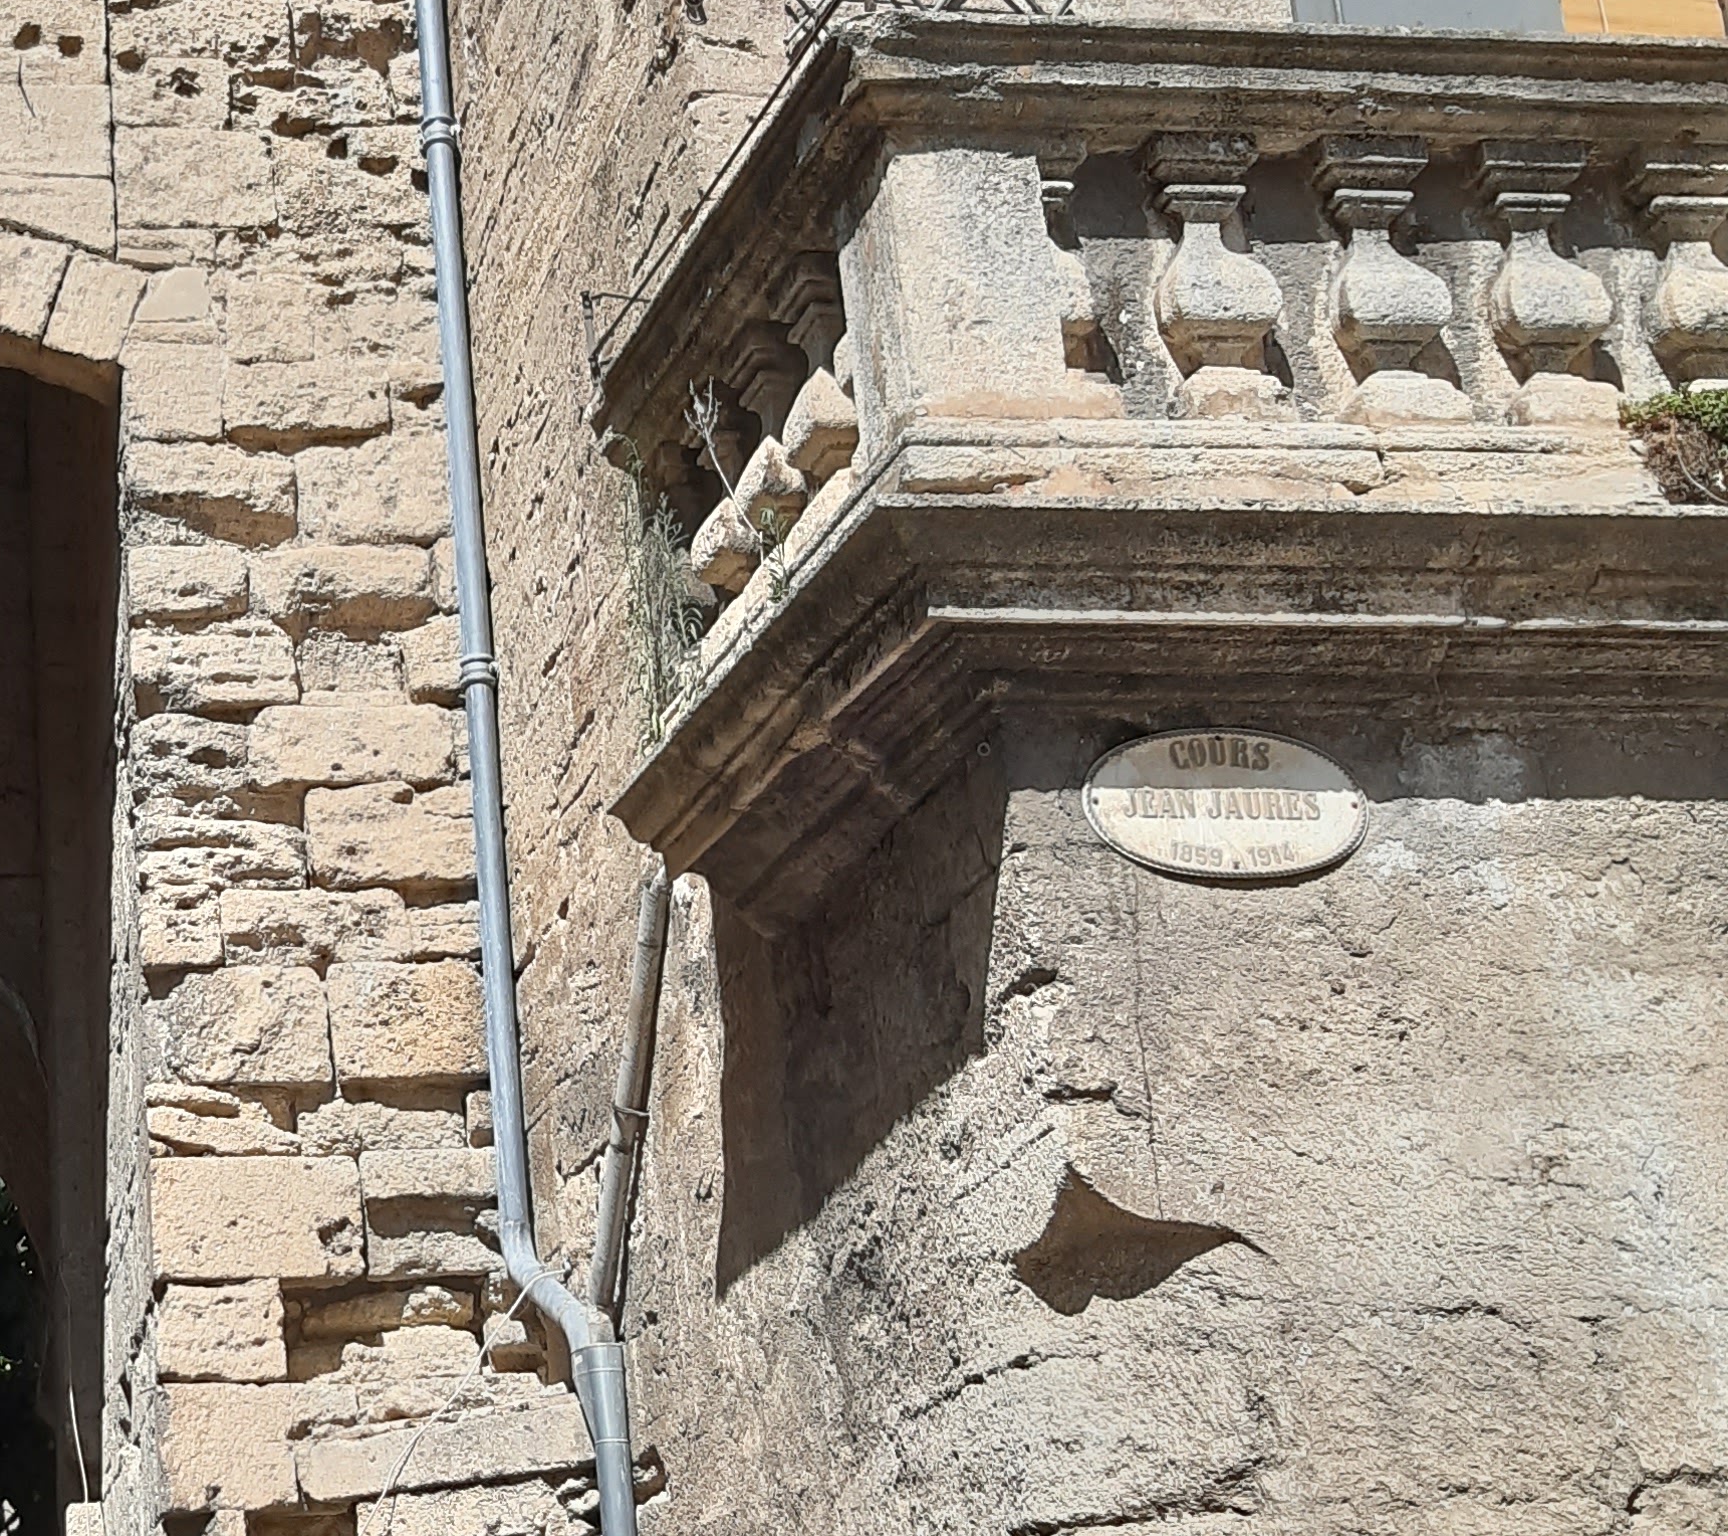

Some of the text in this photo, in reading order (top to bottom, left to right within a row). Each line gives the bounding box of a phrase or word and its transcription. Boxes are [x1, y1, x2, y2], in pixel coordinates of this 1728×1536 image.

[1169, 737, 1271, 771] COURS
[1123, 790, 1322, 821] JEAN JAURES
[1171, 839, 1297, 868] 1859 1914
